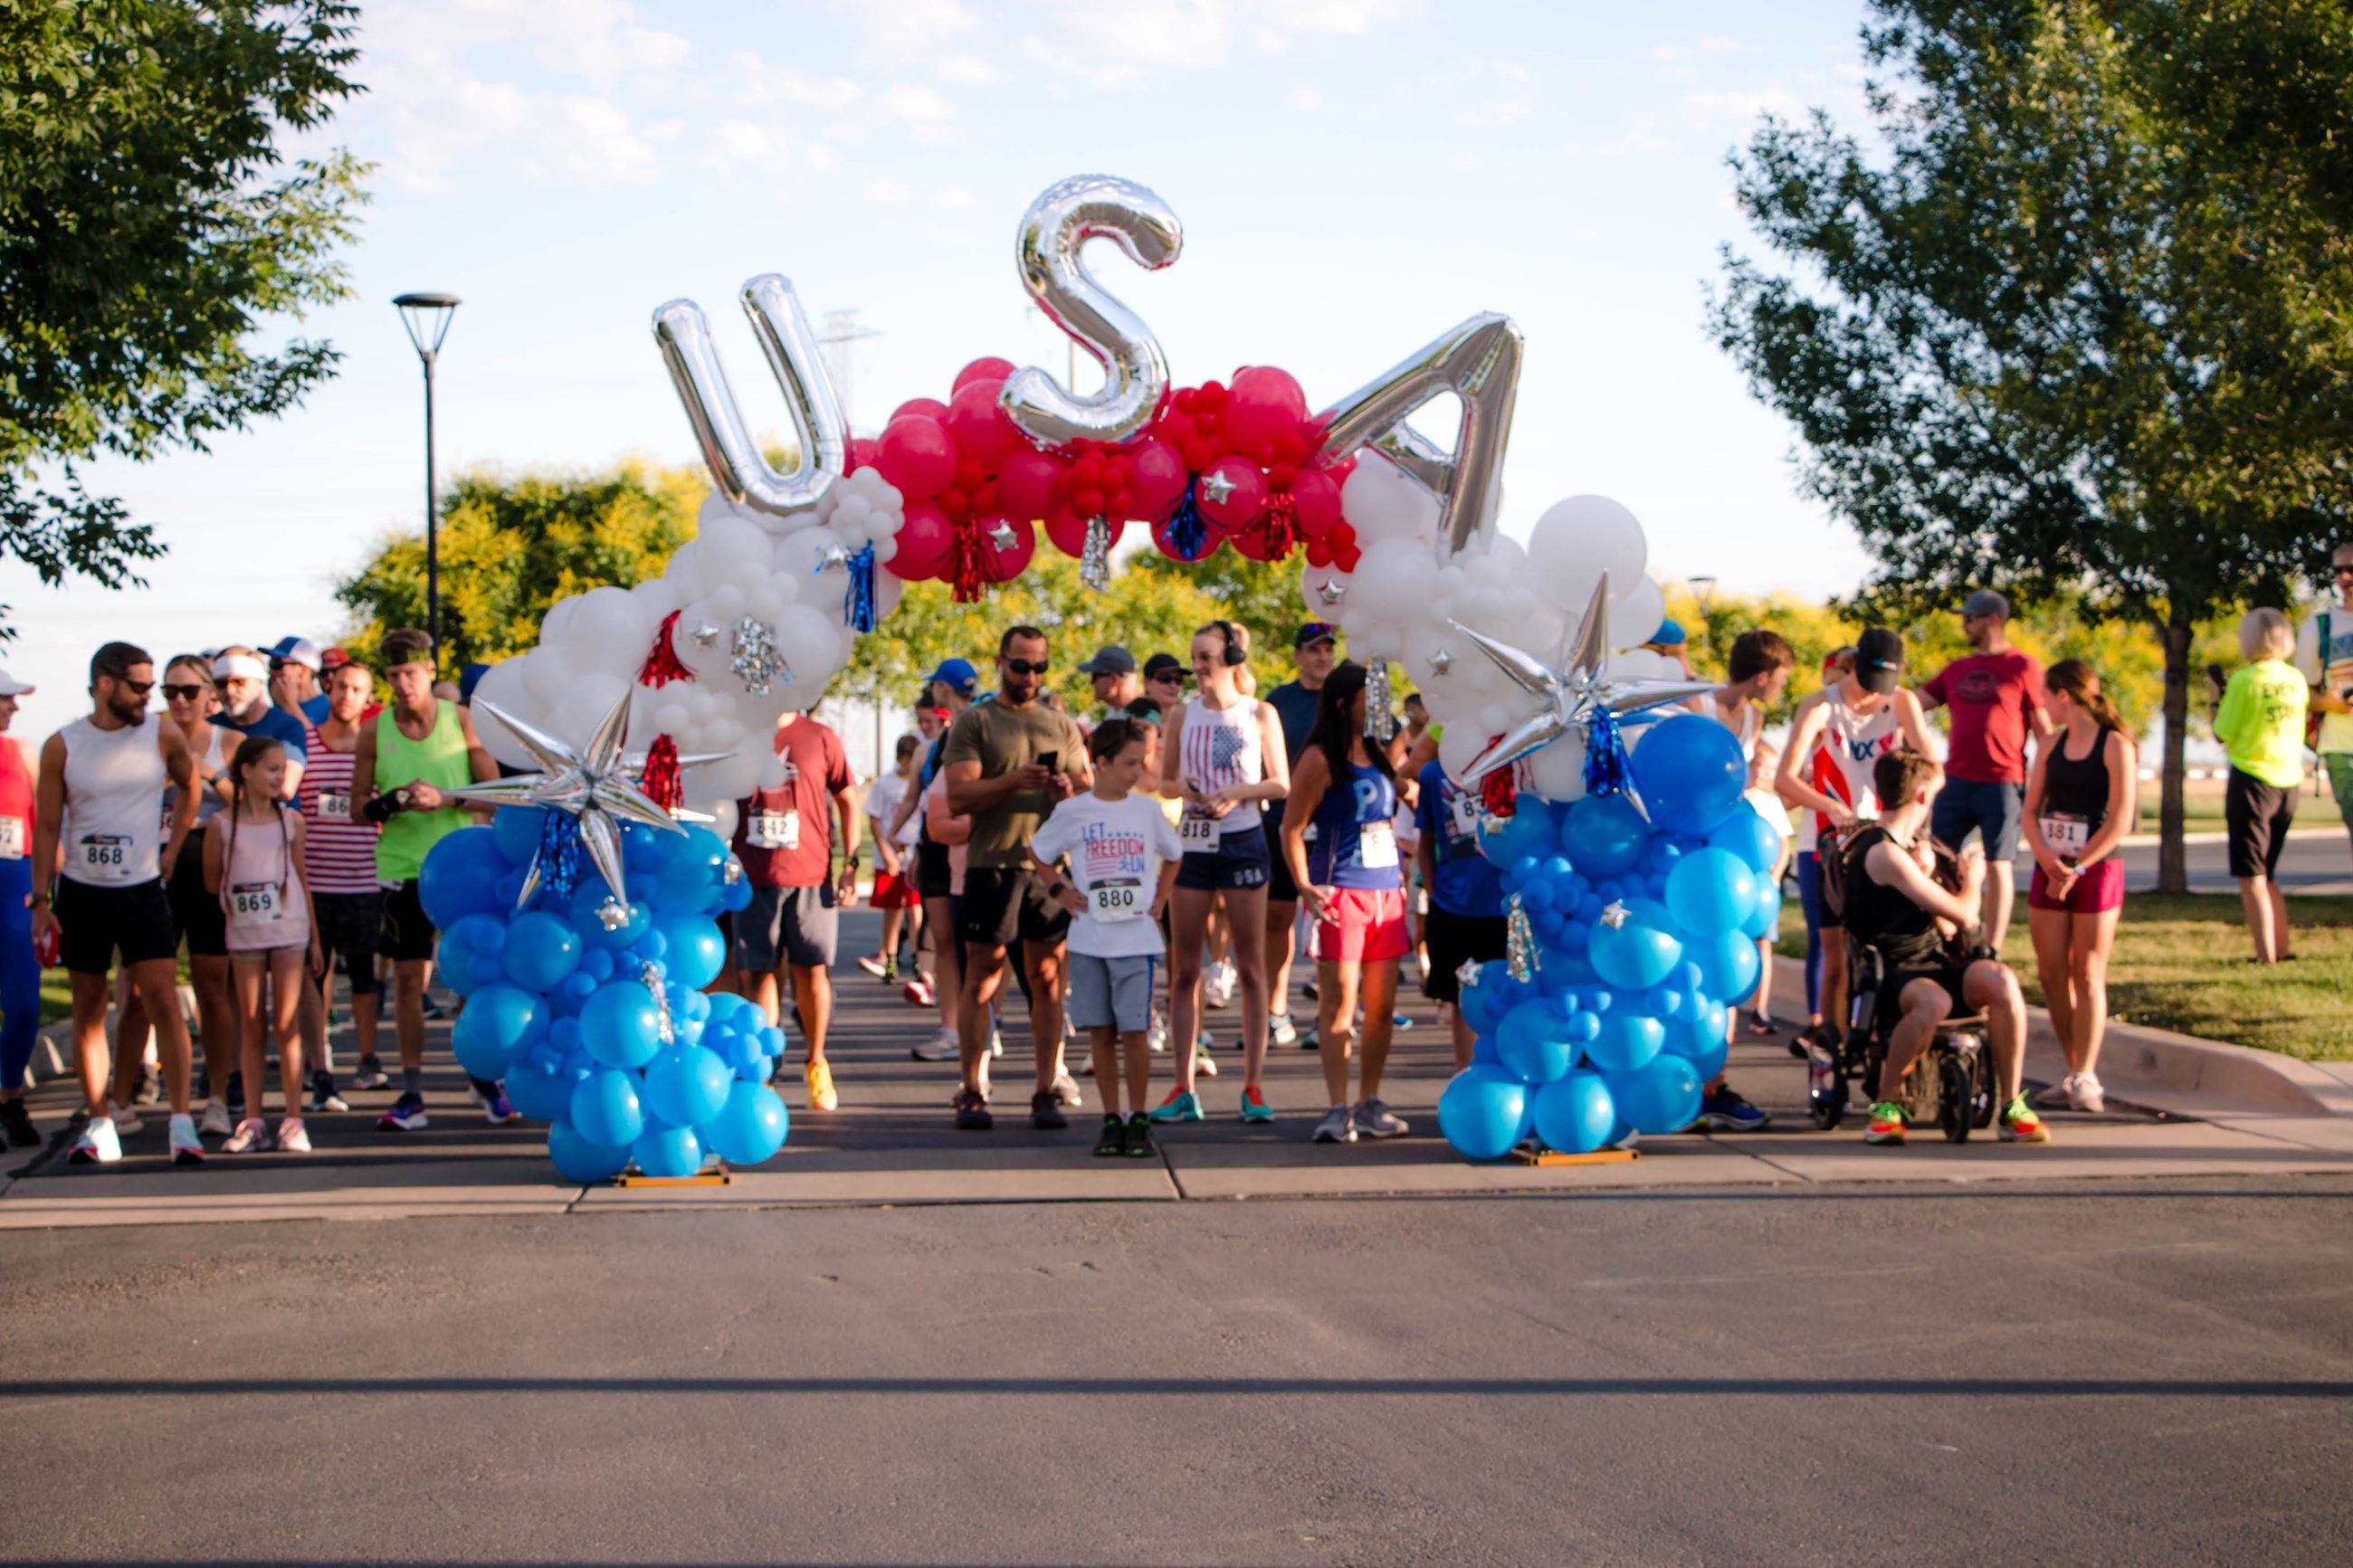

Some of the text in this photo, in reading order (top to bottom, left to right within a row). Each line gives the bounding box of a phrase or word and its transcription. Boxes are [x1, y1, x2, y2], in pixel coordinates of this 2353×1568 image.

[1081, 822, 1105, 841] LET
[88, 847, 122, 864] 868
[1234, 867, 1263, 887] USA
[237, 893, 272, 913] 869
[1099, 889, 1133, 908] 880
